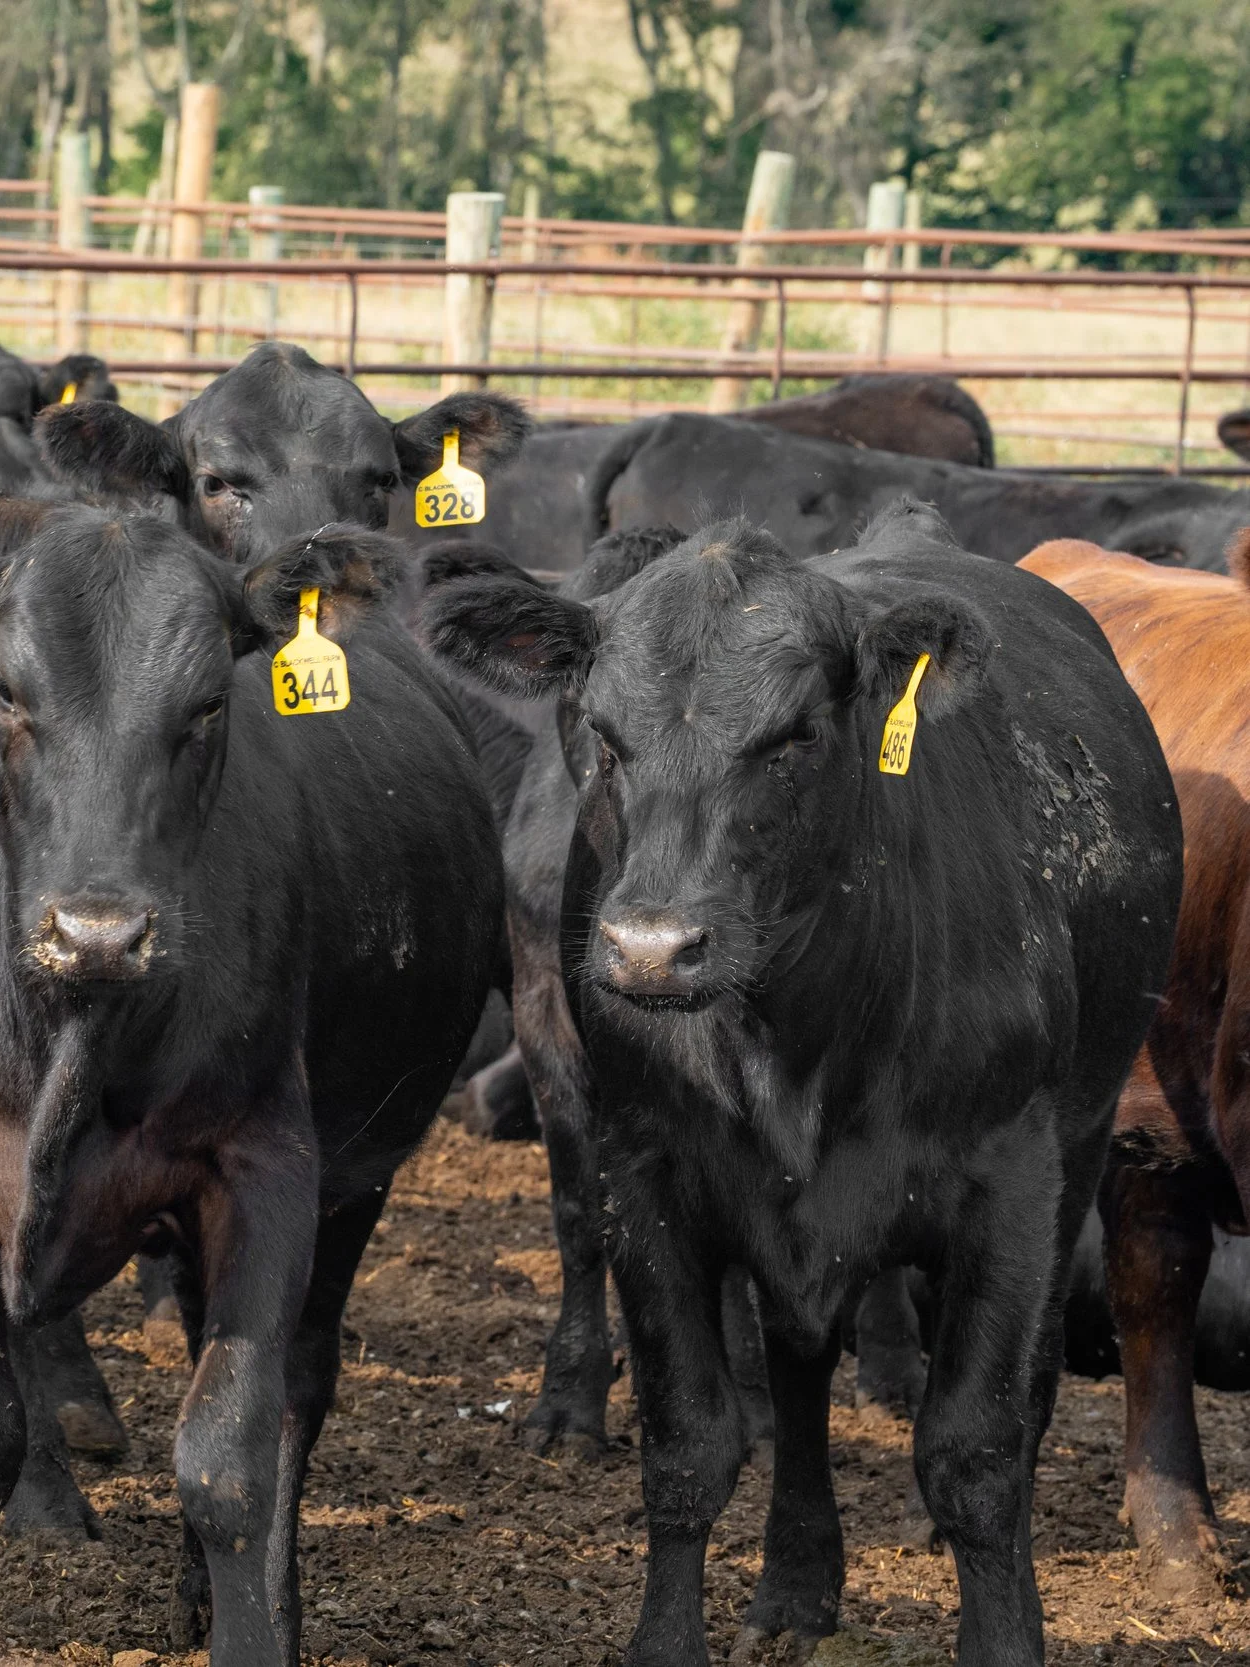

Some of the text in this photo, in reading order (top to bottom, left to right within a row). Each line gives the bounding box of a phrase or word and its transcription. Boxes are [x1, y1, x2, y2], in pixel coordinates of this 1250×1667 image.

[425, 492, 475, 523] 328
[283, 670, 338, 709] 344
[883, 730, 907, 769] 486
